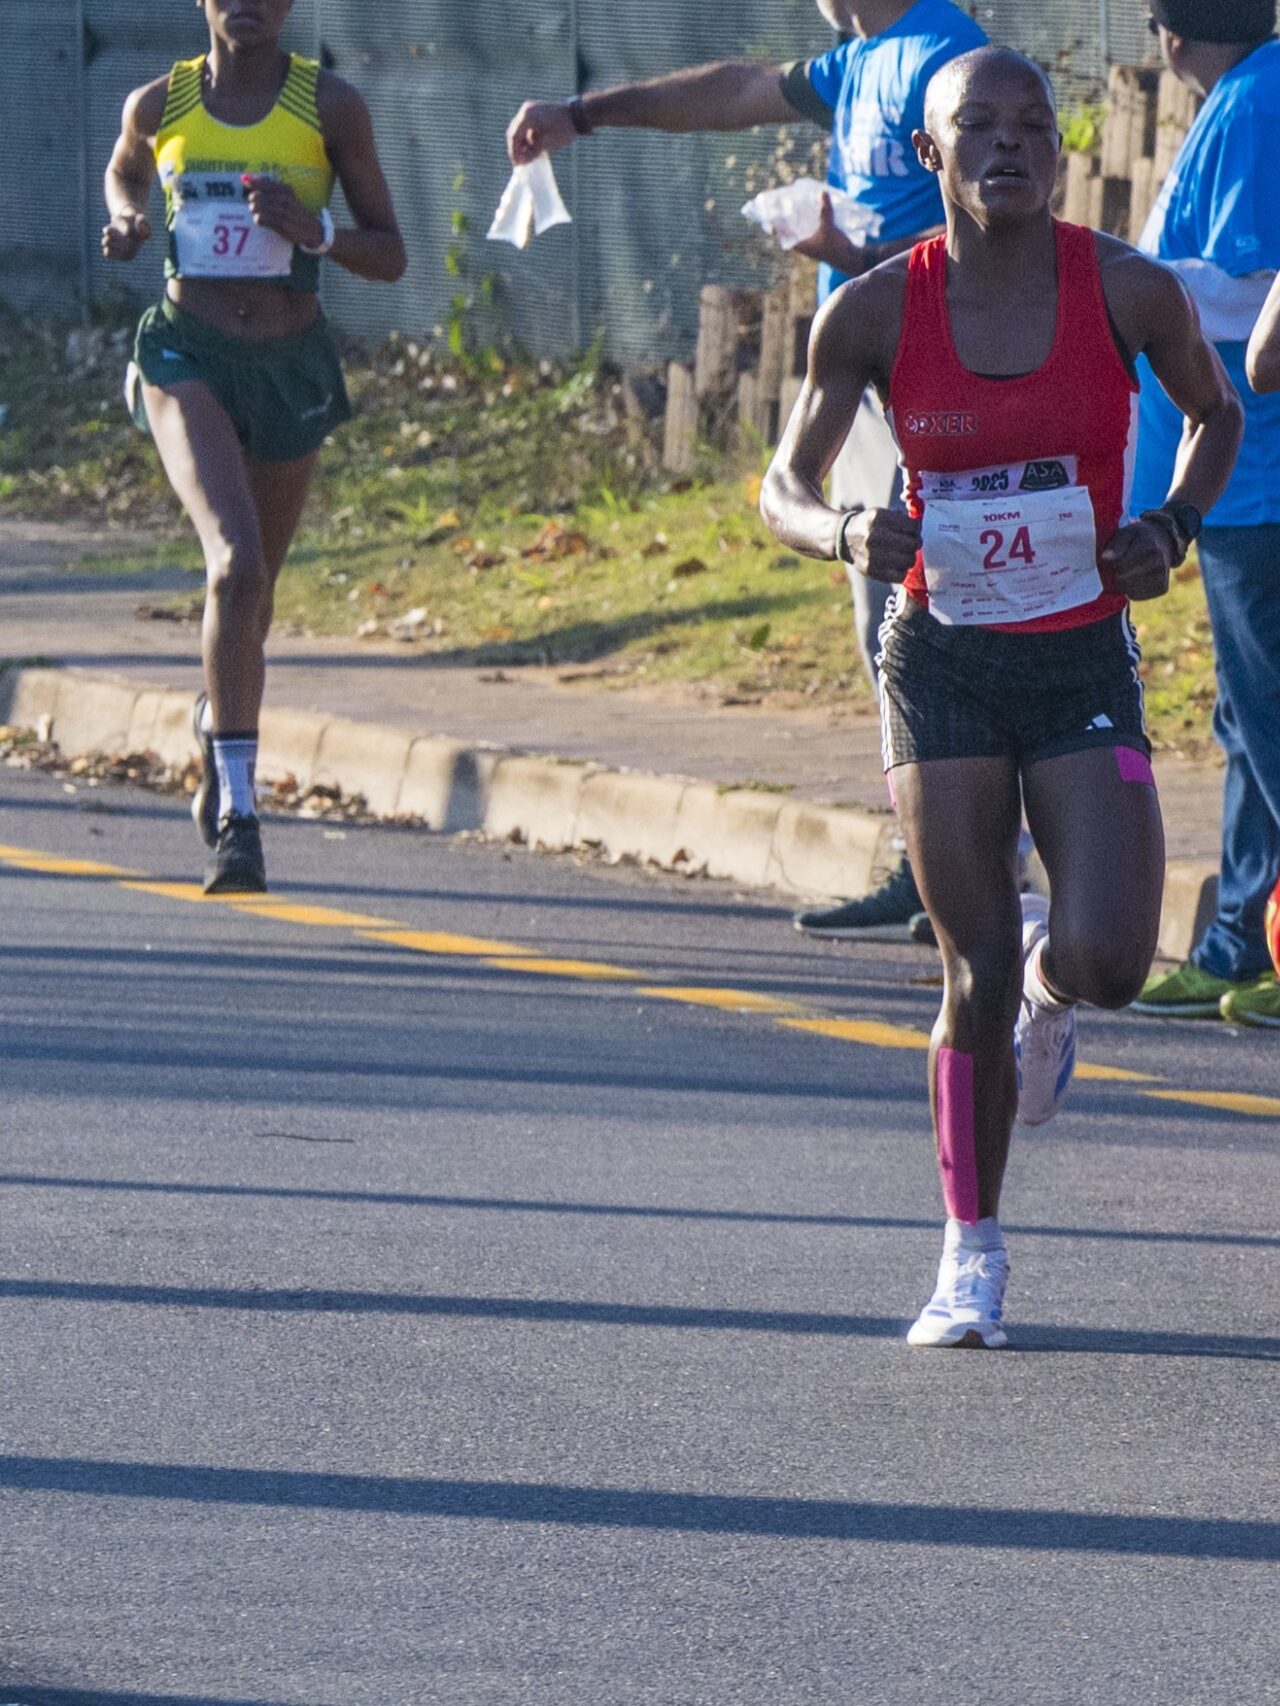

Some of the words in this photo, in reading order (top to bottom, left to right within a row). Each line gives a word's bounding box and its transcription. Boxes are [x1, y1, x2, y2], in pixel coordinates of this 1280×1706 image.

[212, 225, 250, 255] 37
[1026, 464, 1063, 478] ASA
[982, 511, 1021, 522] 10KM
[979, 525, 1036, 570] 24
